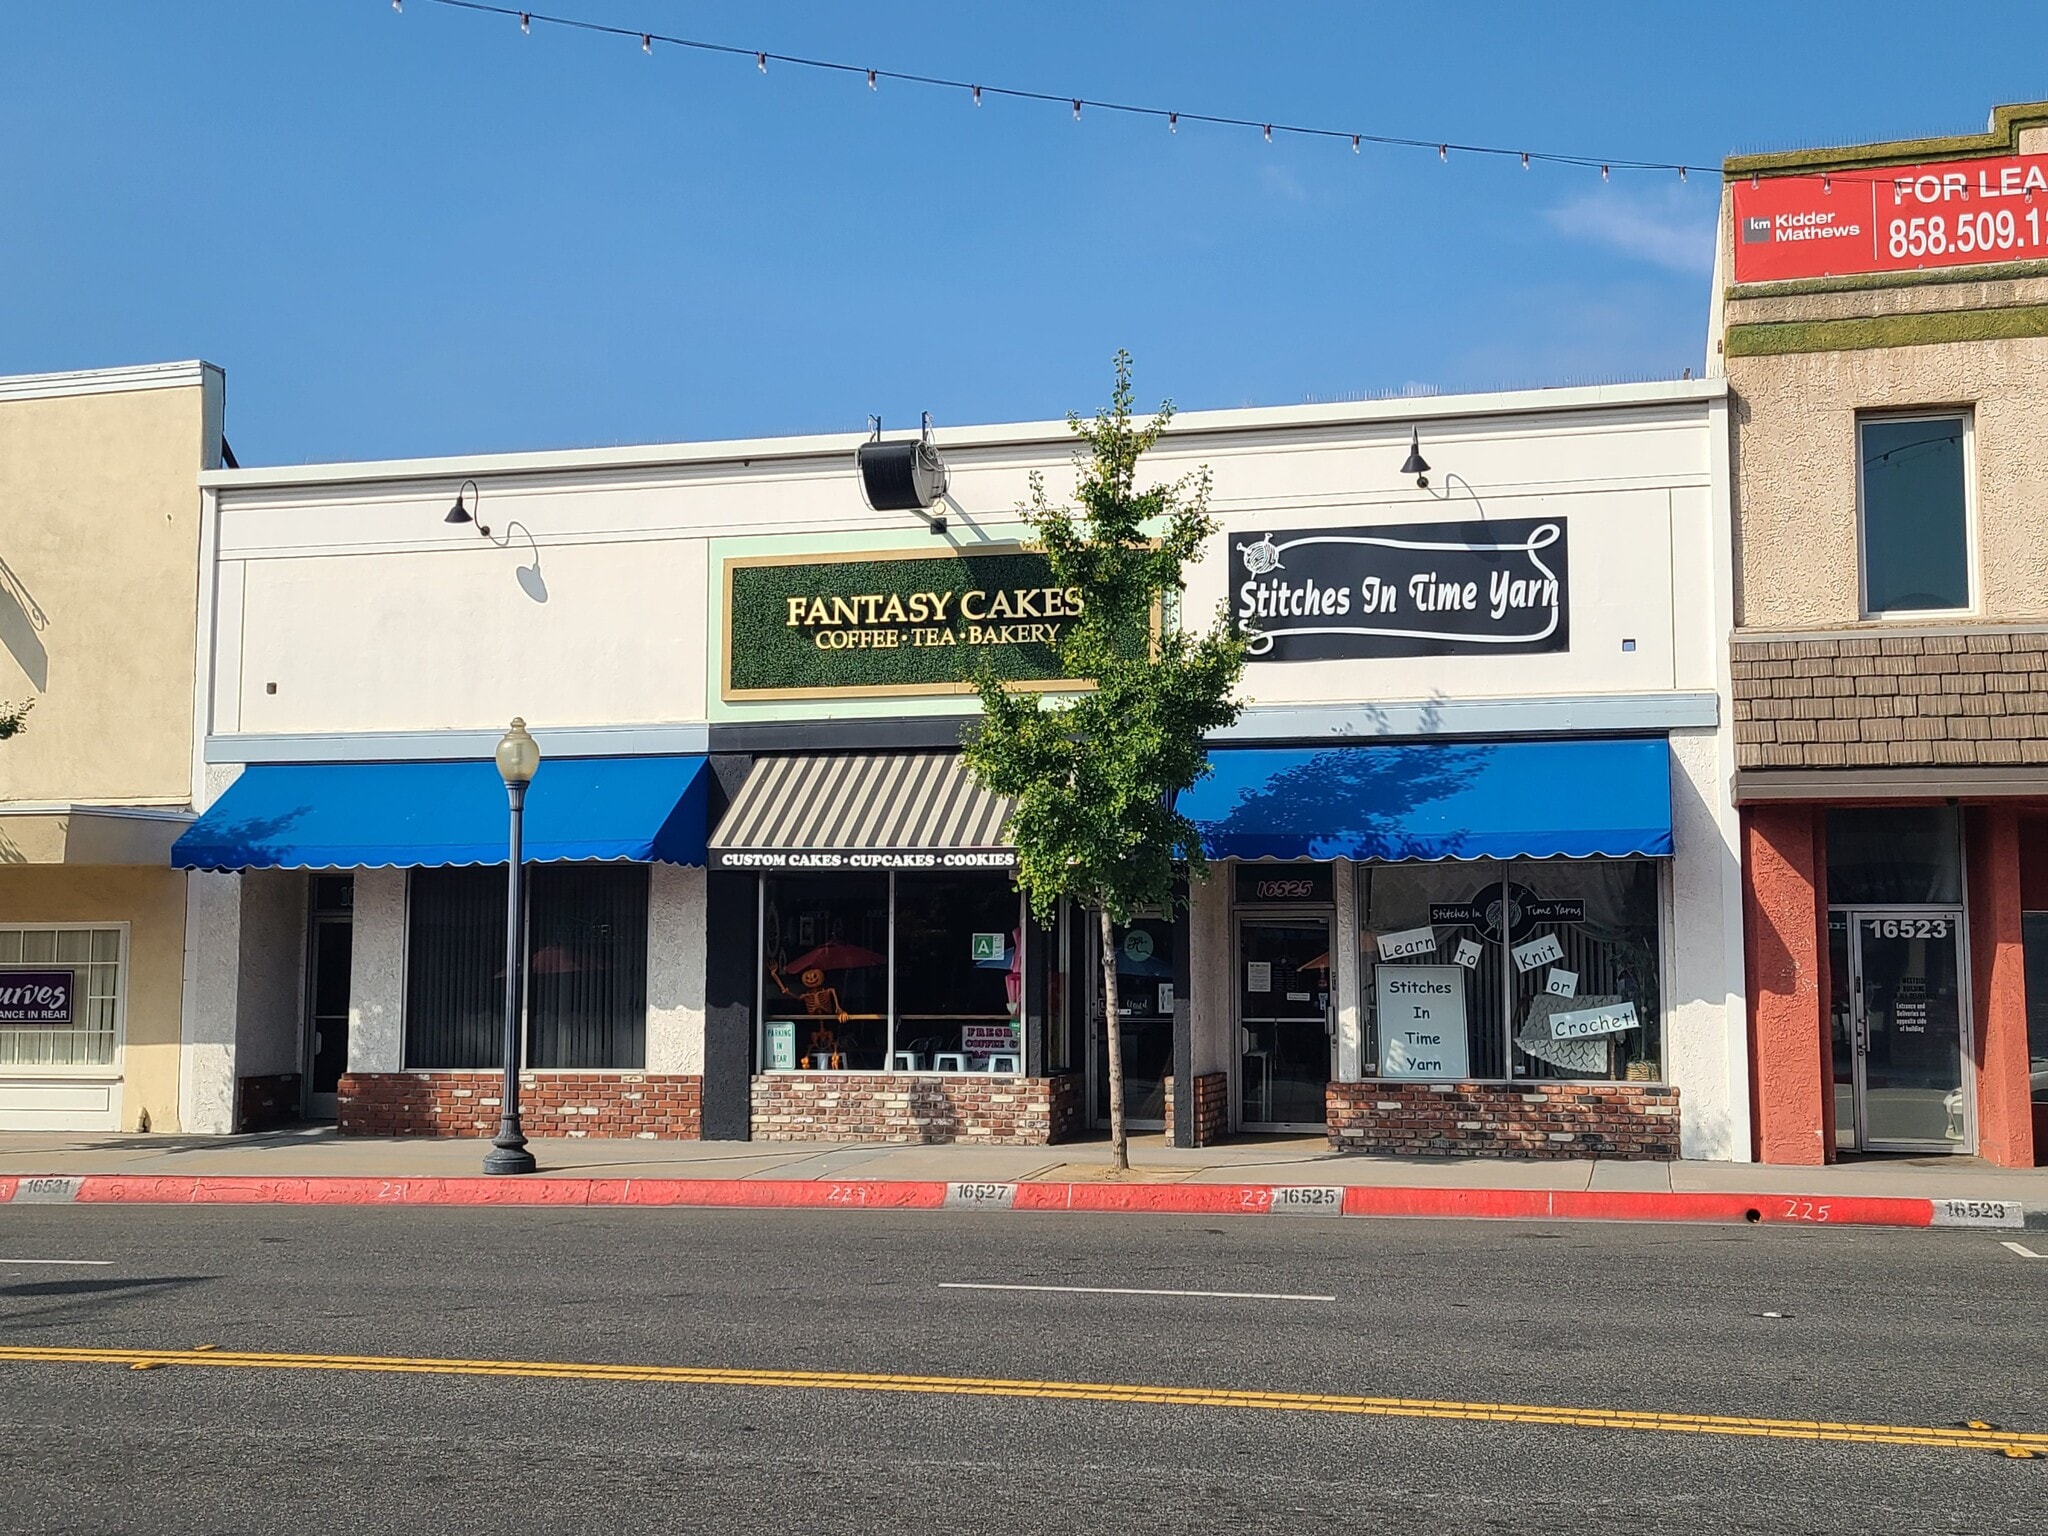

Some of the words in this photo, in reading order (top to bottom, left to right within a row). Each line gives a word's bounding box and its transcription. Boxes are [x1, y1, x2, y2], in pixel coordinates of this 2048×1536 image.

[1894, 172, 1967, 205] FOR
[1979, 165, 2048, 198] LEA
[1750, 217, 1771, 231] km
[1775, 211, 1836, 228] Kidder
[1775, 223, 1861, 243] Mathews
[1888, 207, 2048, 259] 858.509.1
[1238, 577, 1351, 619] Stitches
[1361, 576, 1397, 614] In
[1408, 571, 1478, 612] Time
[1489, 570, 1559, 620] Yarn
[785, 591, 953, 627] FANTASY
[960, 587, 1086, 621] CAKES
[815, 629, 899, 650] COFFEE
[911, 627, 957, 647] TEA
[968, 623, 1062, 646] BAKERY
[721, 854, 787, 867] CUSTOM
[788, 854, 842, 867] CAKES
[849, 853, 936, 867] CUPCAKES
[943, 853, 1015, 867] COOKIES
[1257, 880, 1313, 898] 16525
[1432, 908, 1470, 920] Stitches
[1471, 909, 1482, 918] In
[1525, 904, 1551, 916] Time
[1554, 903, 1582, 917] Yarns
[1869, 920, 1948, 939] 16523
[977, 939, 990, 954] A
[1381, 937, 1436, 959] Learn
[1458, 948, 1477, 966] to
[1519, 945, 1557, 969] Knit
[1389, 981, 1452, 994] Stitches
[1550, 981, 1571, 995] or
[0, 984, 66, 1010] urves
[27, 1010, 39, 1019] IN
[41, 1010, 67, 1019] REAR
[1413, 1006, 1430, 1020] In
[1555, 1009, 1638, 1037] Crochet!
[1405, 1031, 1441, 1045] Time
[1406, 1058, 1442, 1071] Yarn
[956, 1183, 1008, 1200] 16527
[1281, 1188, 1335, 1205] 16525
[1783, 1200, 1832, 1222] 225
[1945, 1201, 2006, 1219] 16523
